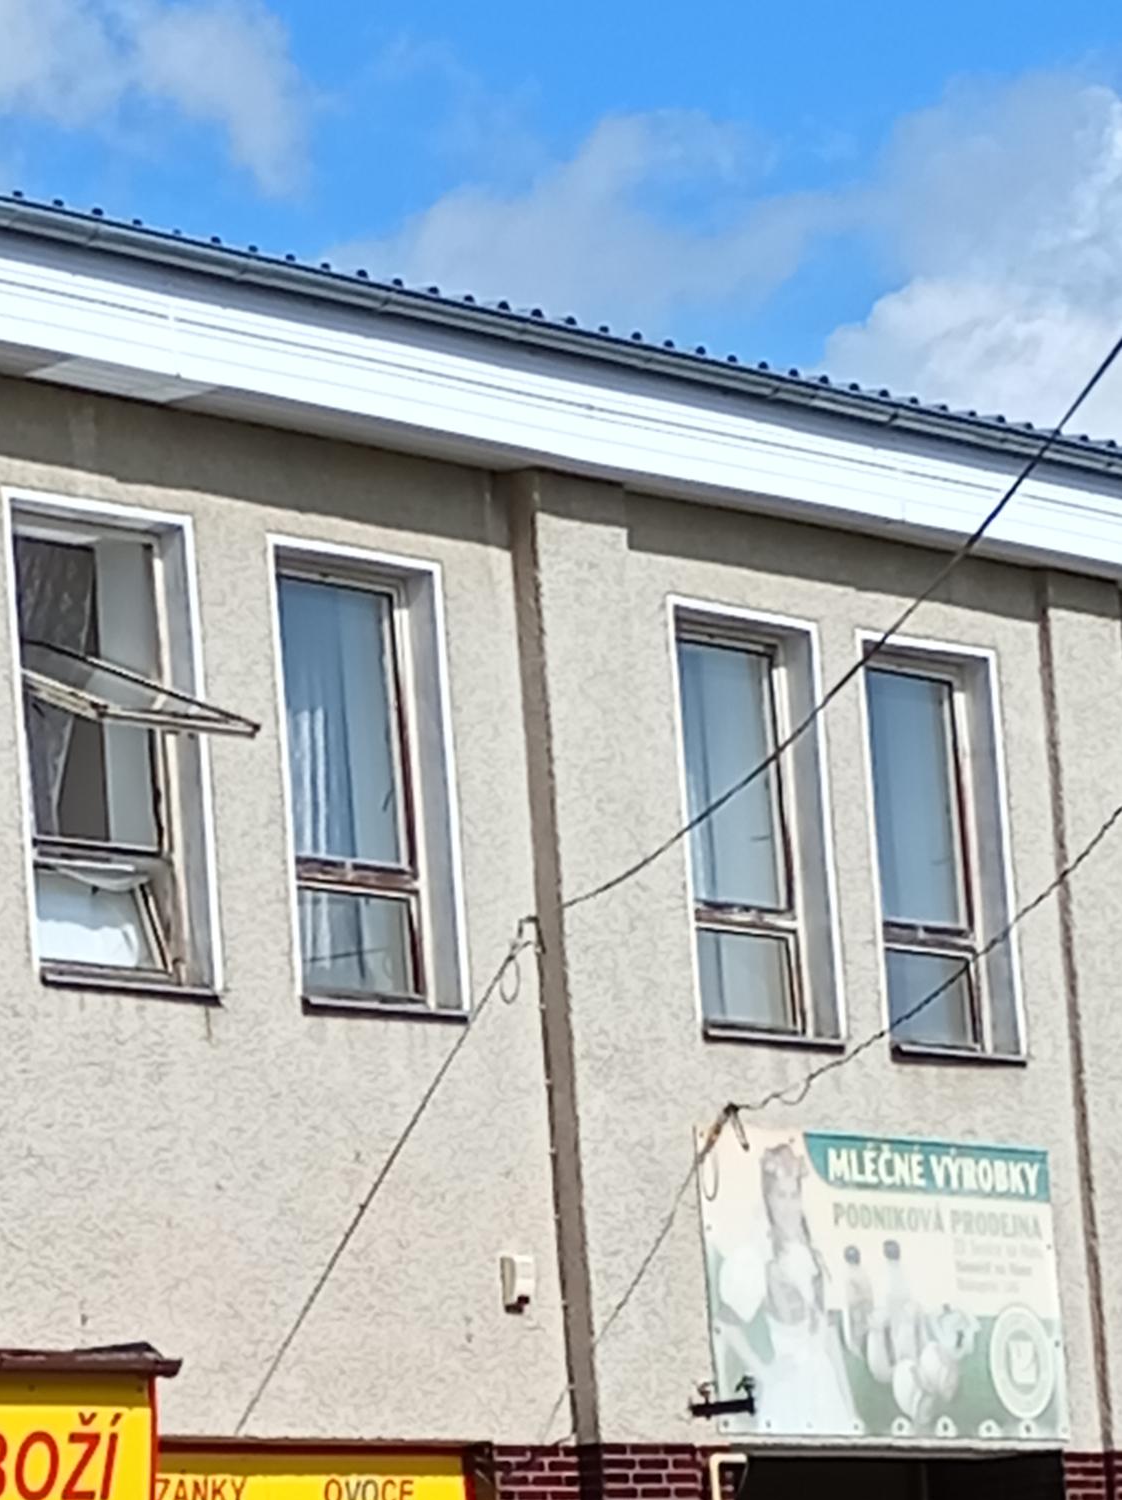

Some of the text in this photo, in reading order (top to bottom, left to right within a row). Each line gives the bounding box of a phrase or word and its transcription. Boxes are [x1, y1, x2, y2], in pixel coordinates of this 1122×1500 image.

[827, 1142, 1039, 1196] MLÉČNÉ VÝROBKY
[832, 1201, 1043, 1240] PODNIKOVÁ PRODEJNA
